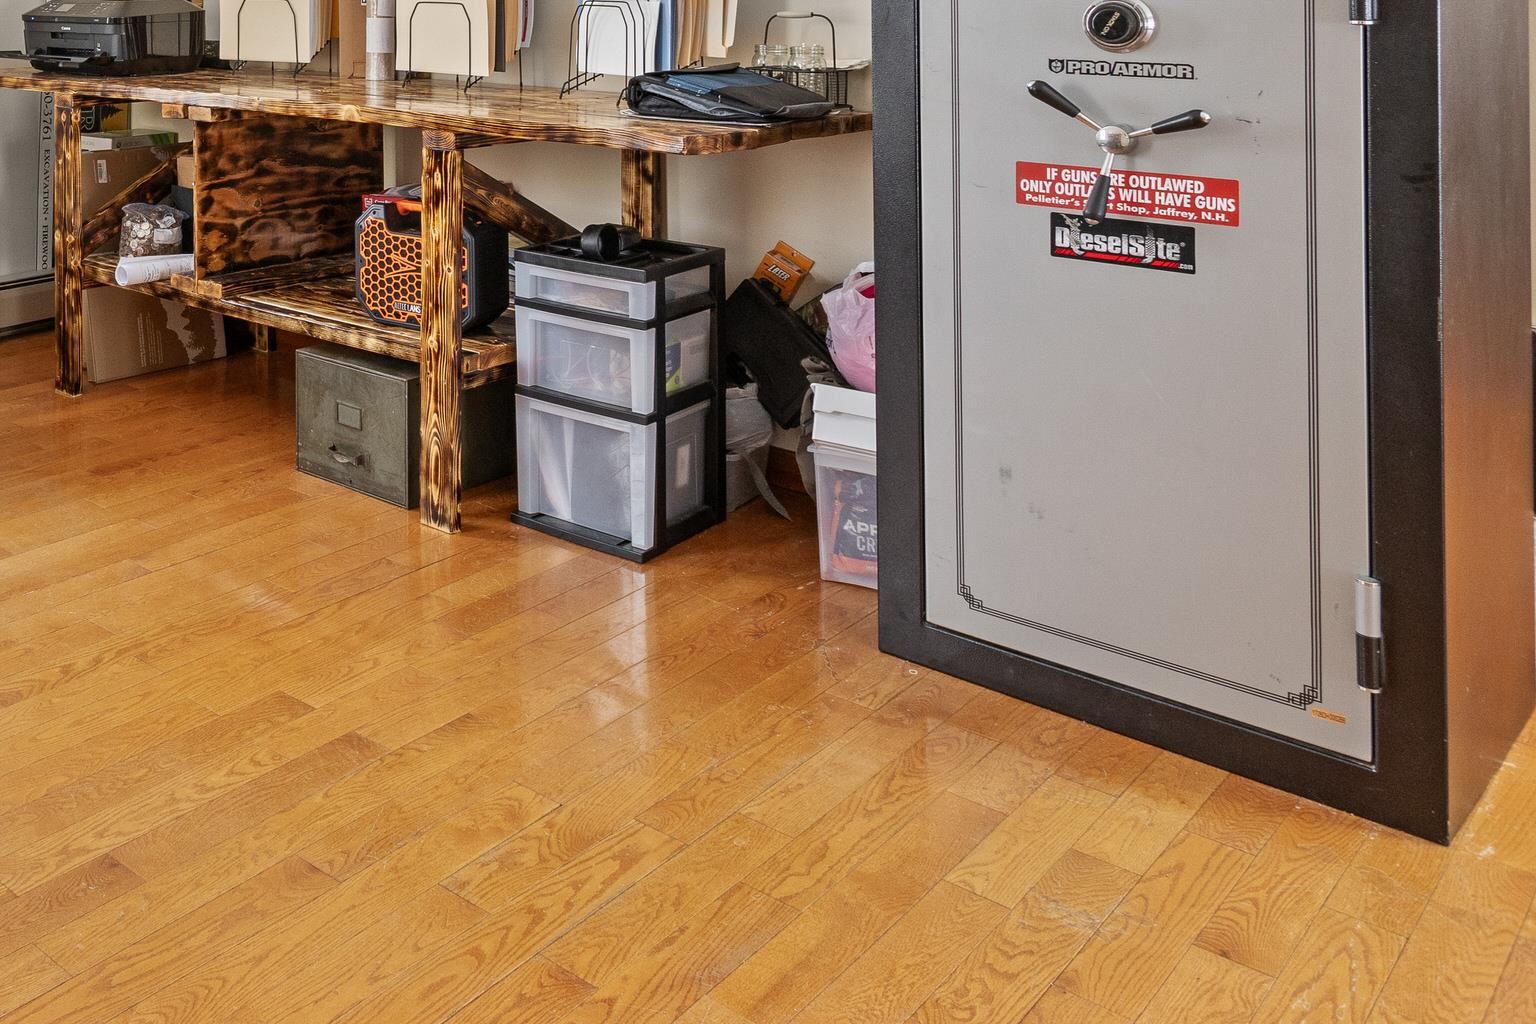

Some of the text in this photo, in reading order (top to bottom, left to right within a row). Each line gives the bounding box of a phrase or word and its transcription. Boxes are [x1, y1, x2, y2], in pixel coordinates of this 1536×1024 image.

[1067, 61, 1193, 78] PRO ARMOR
[42, 149, 50, 214] EXCAVATION
[1020, 179, 1052, 193] ONLY
[1119, 189, 1151, 204] WILL
[1155, 192, 1191, 208] HAVE
[1195, 195, 1235, 212] GUNS
[1046, 167, 1205, 193] IF GUNS RE OUTLAWED
[1025, 193, 1080, 207] Pelletier's
[1116, 203, 1149, 216] Shop,
[1152, 206, 1198, 221] Jaffrey,
[1201, 211, 1229, 222] N.H.
[41, 226, 49, 270] FIREWOO
